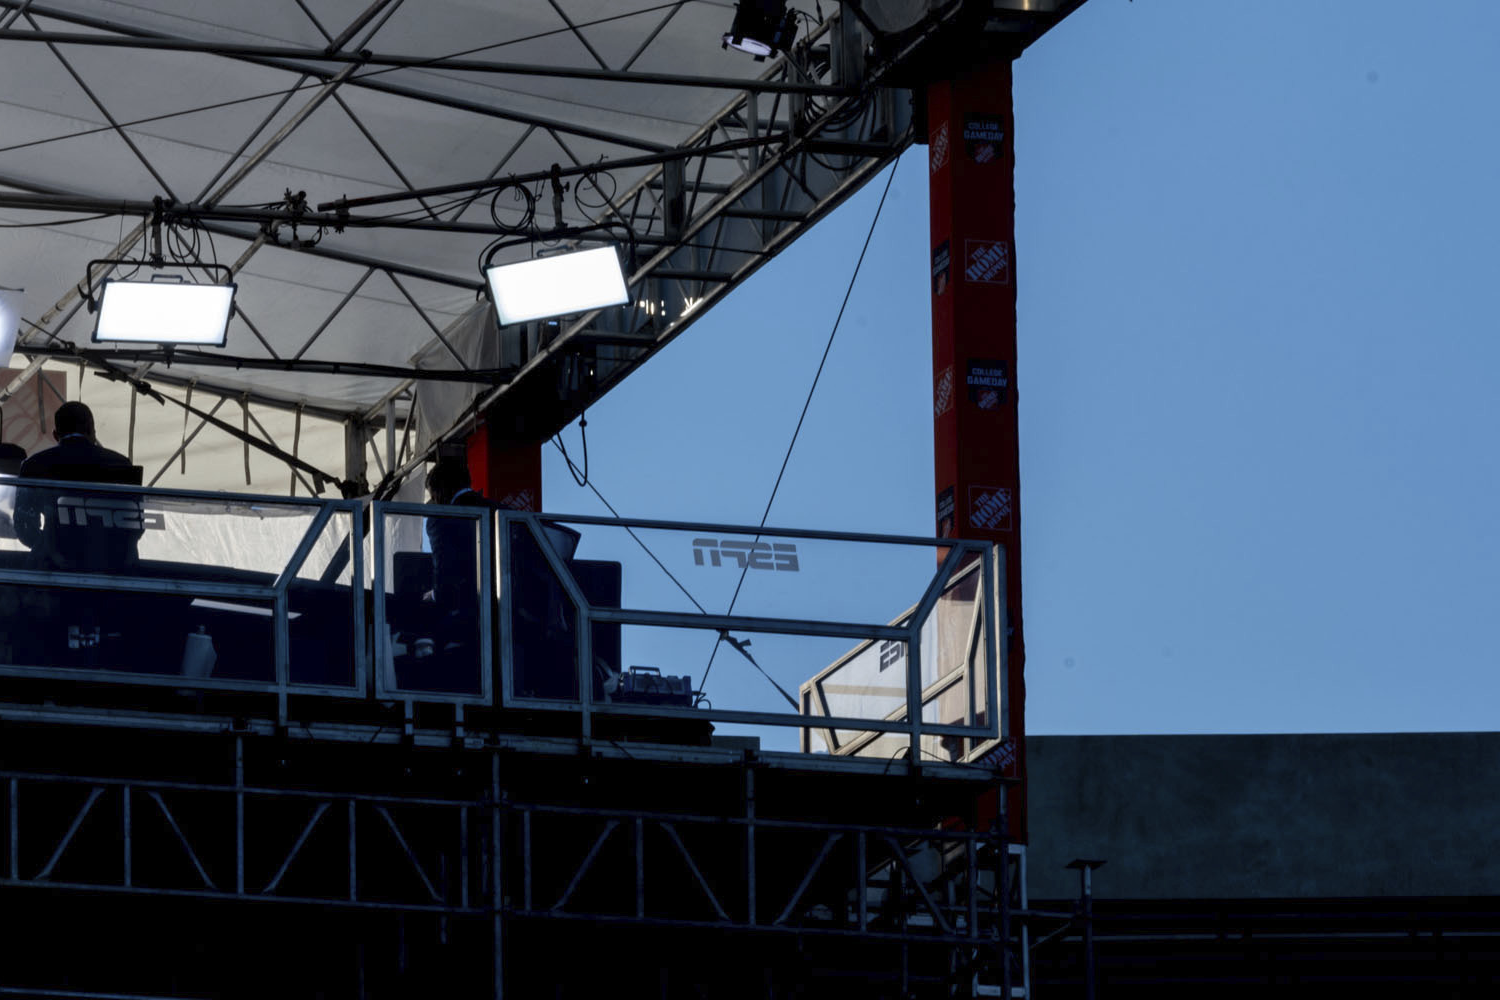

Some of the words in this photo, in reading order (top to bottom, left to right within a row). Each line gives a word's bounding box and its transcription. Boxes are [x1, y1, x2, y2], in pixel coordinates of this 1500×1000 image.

[963, 130, 1004, 141] GAMEDAY
[966, 241, 1008, 281] HOME
[967, 375, 1008, 387] GAMEDAY
[970, 487, 1012, 528] HOME
